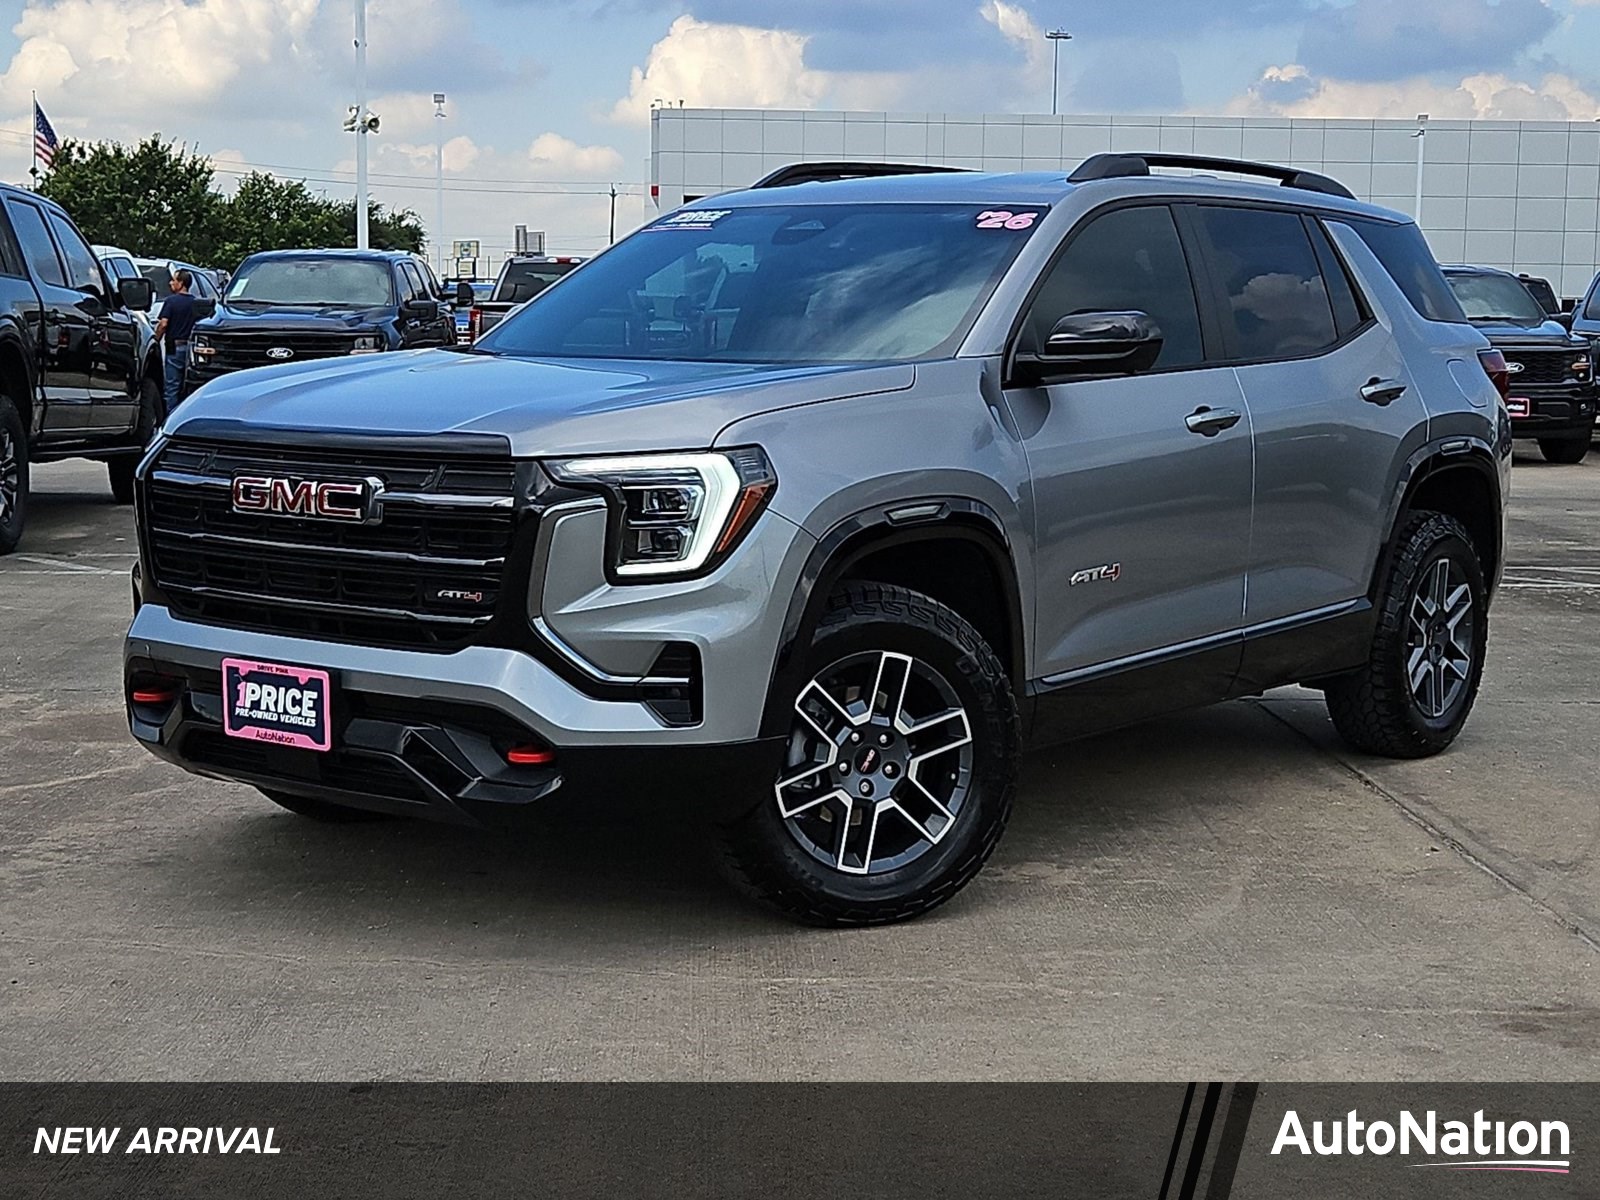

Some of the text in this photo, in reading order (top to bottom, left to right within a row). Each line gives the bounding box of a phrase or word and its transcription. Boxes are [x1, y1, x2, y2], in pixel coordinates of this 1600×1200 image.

[232, 476, 363, 519] GMC
[1070, 562, 1120, 586] AT4
[437, 589, 482, 602] AT4
[234, 706, 317, 727] PRE-OWNED VEHICLES
[255, 730, 296, 744] AutoNation
